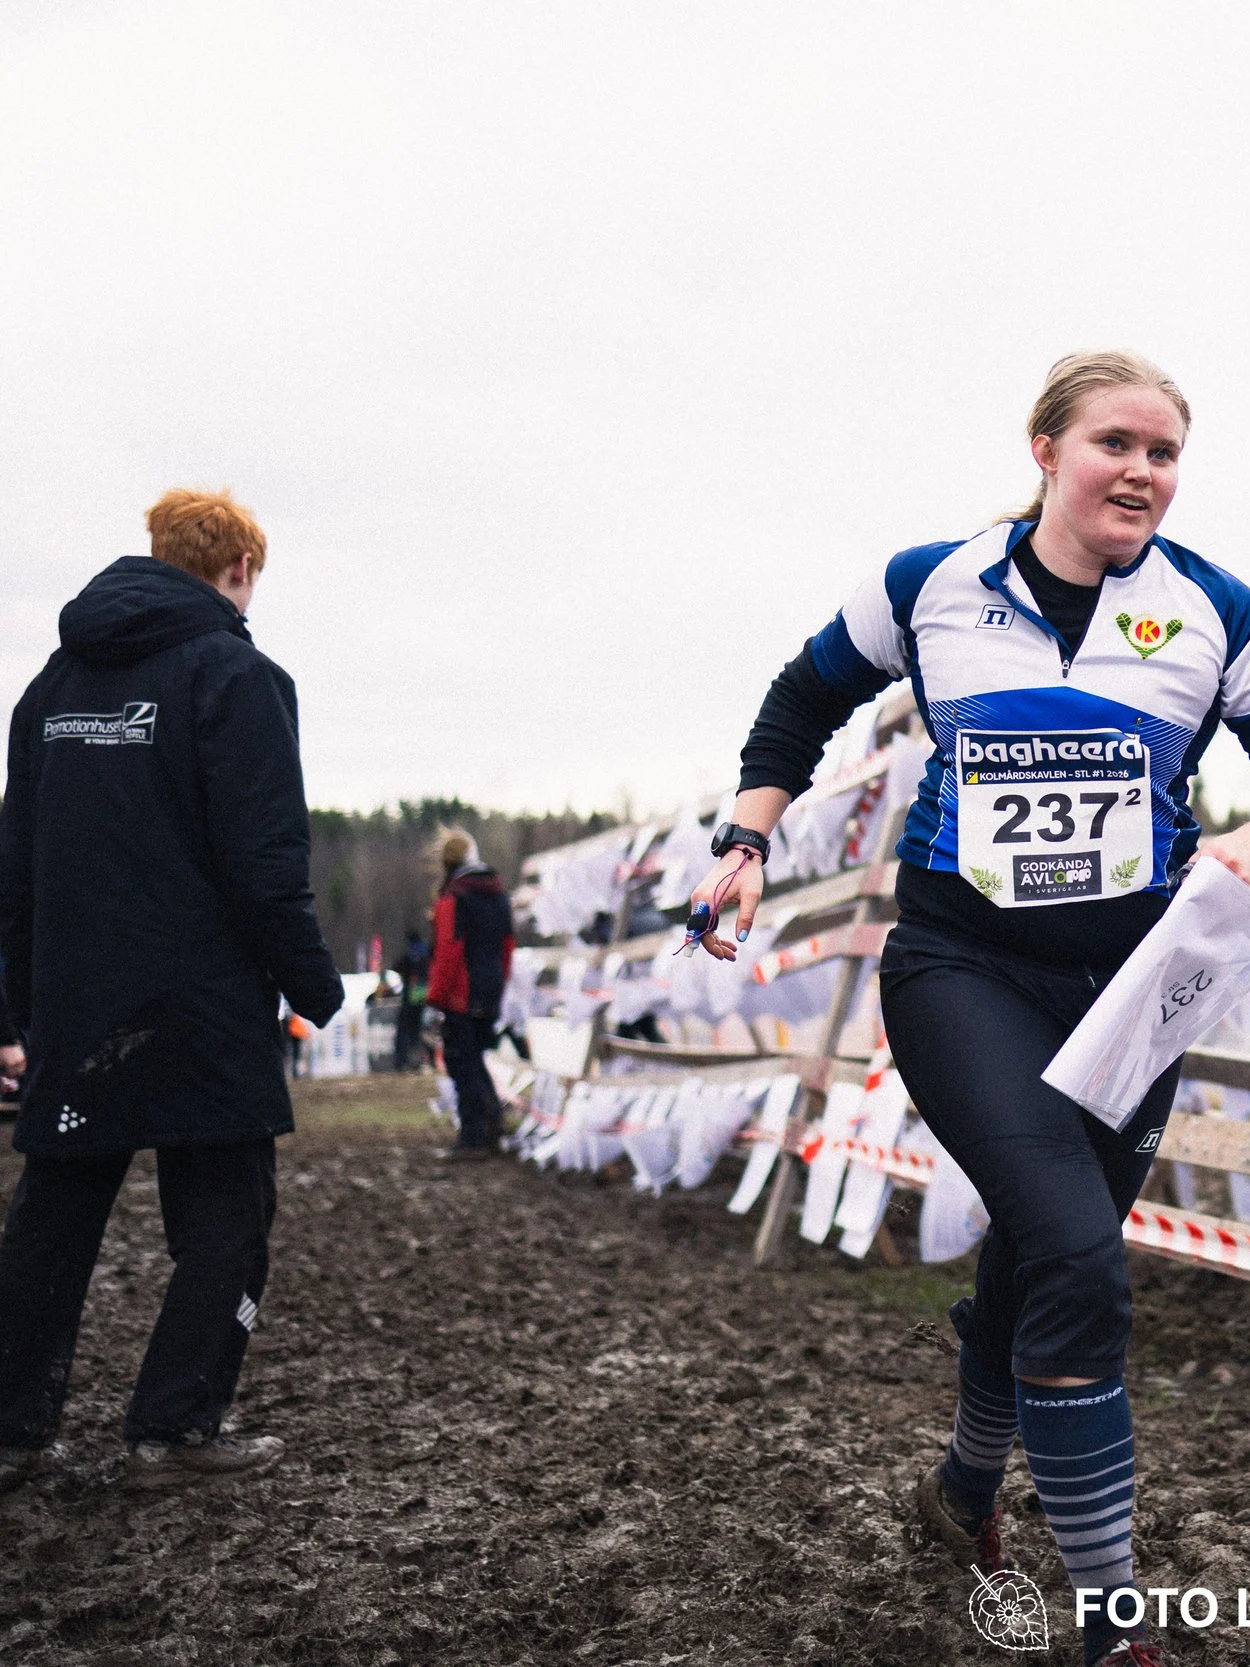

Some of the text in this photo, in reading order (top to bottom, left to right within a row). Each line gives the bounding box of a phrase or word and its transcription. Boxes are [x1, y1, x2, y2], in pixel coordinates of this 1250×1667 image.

[1140, 620, 1158, 643] K
[962, 735, 1143, 767] bagheera
[979, 769, 1067, 781] KOLMÅRDSKAVLEN
[1074, 770, 1091, 778] STL
[1106, 769, 1129, 778] 2026
[992, 792, 1119, 844] 237
[1020, 858, 1093, 873] GODKÄNDA
[1020, 868, 1092, 886] AVLOPP
[1036, 886, 1072, 894] SVERIGE
[1161, 969, 1212, 1025] 237
